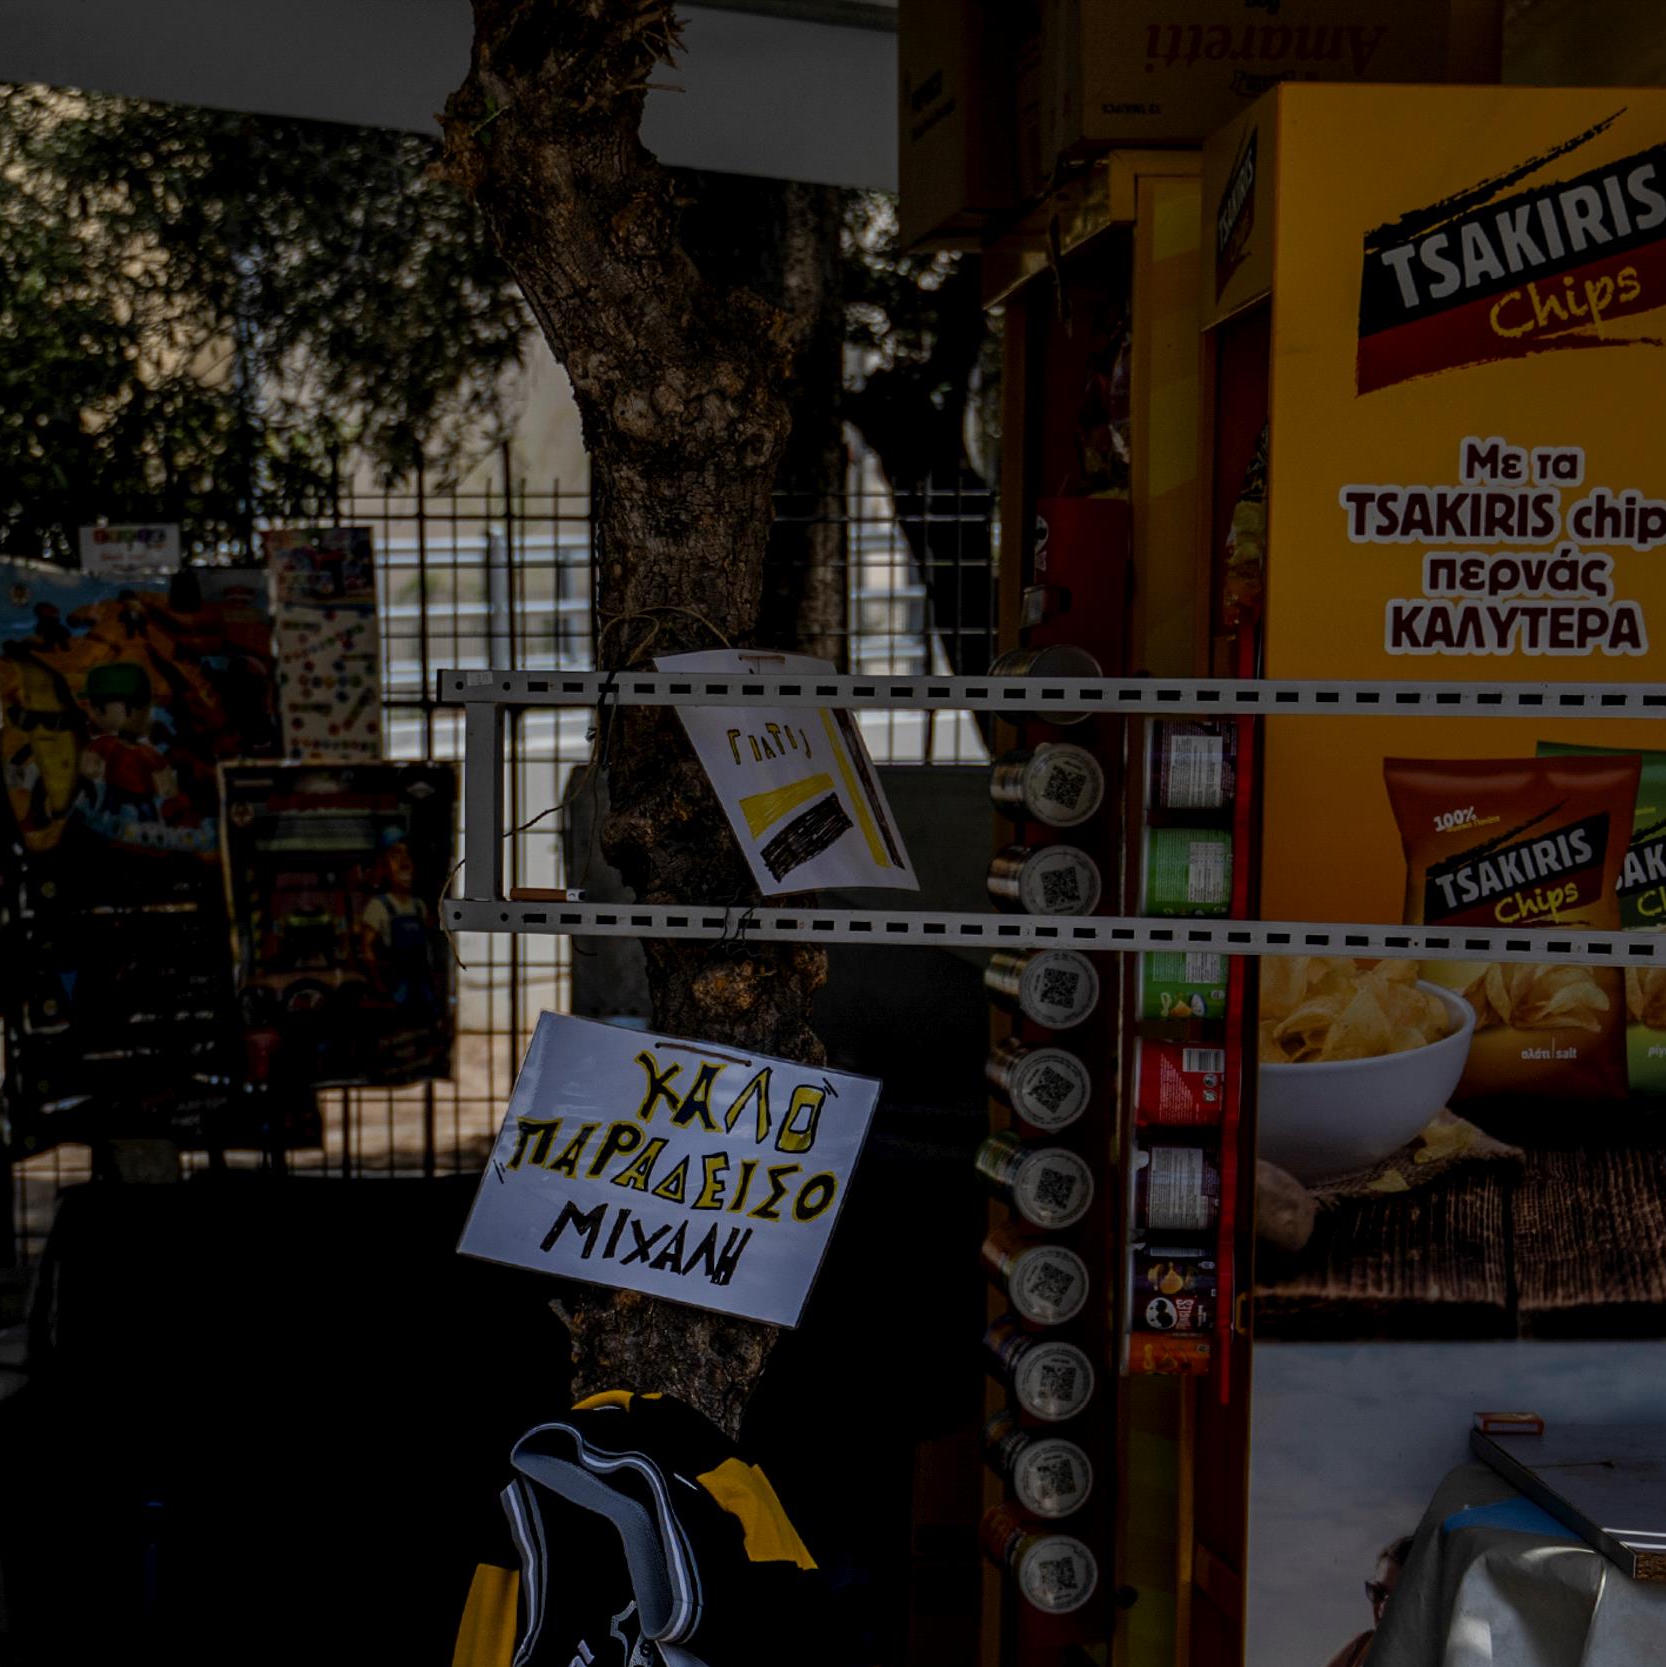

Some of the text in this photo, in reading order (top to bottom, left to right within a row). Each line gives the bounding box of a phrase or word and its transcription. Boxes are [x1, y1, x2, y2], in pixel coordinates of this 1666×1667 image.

[1145, 24, 1388, 78] Amaretti
[1488, 263, 1642, 341] Chips
[1466, 443, 1578, 480] Με τα
[1346, 492, 1554, 537] TSAKIRIS
[1430, 548, 1608, 597] περνάς
[1391, 606, 1642, 649] ΚΑΛΥΤΕΡΑ
[1435, 827, 1595, 910] TSAKIRIS
[1493, 880, 1581, 924] Chips
[636, 1049, 827, 1154] ΚΑΛΟ
[506, 1115, 839, 1222] ΠΑΡΑΔΕΙΣΟ
[539, 1200, 753, 1286] ΜΙΧΑΛΗ
